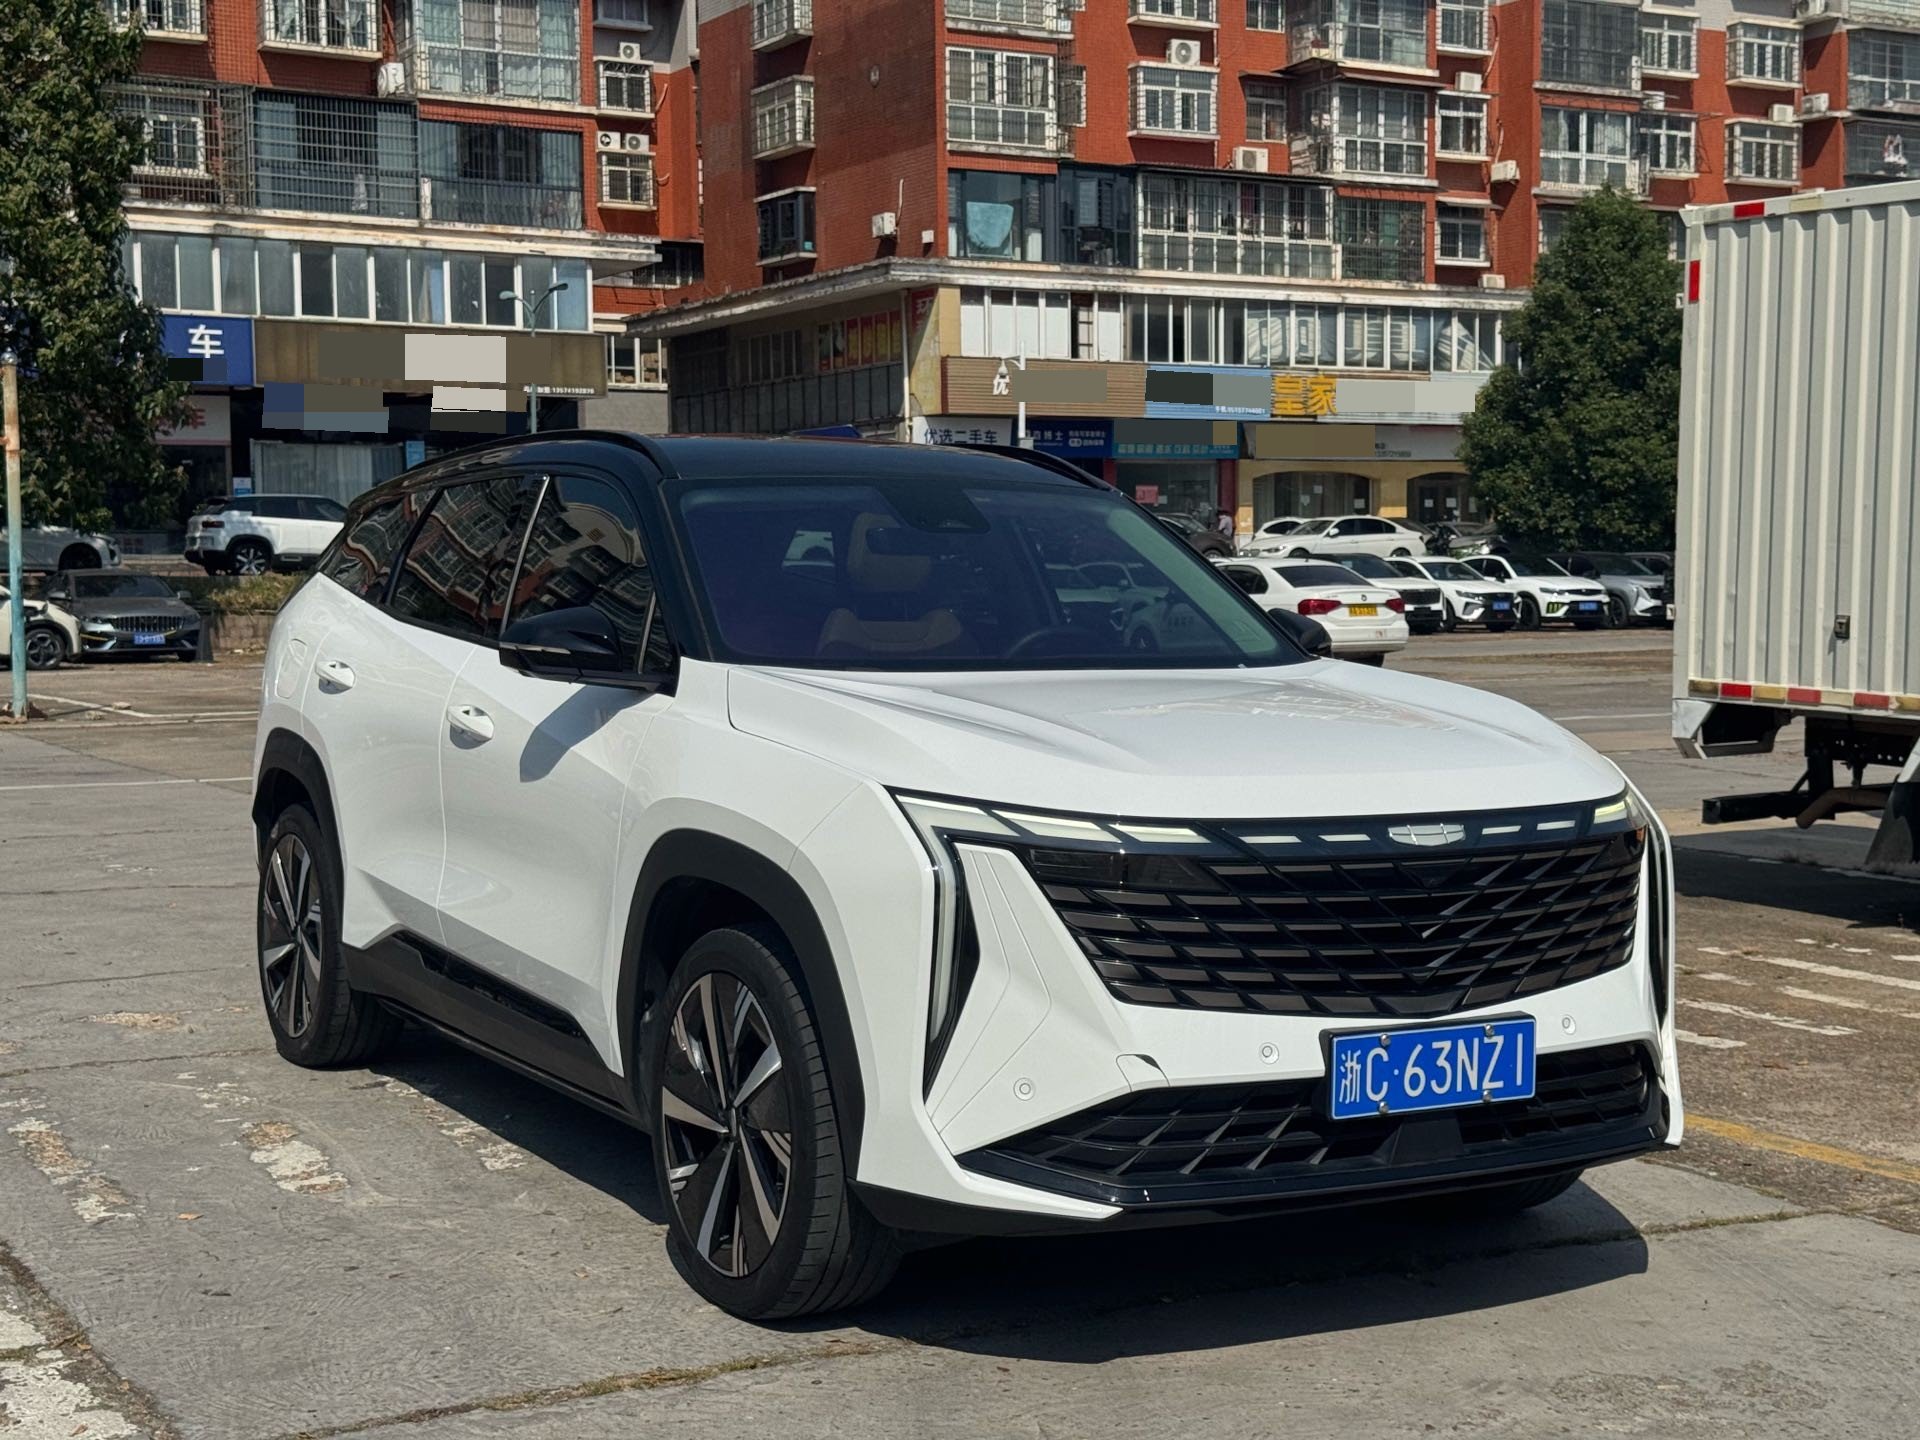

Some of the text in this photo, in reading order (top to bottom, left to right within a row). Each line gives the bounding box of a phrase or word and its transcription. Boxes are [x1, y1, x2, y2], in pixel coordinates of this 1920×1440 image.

[187, 323, 225, 359] 车
[1272, 374, 1338, 416] 皇家
[924, 427, 998, 446] 优选二手车
